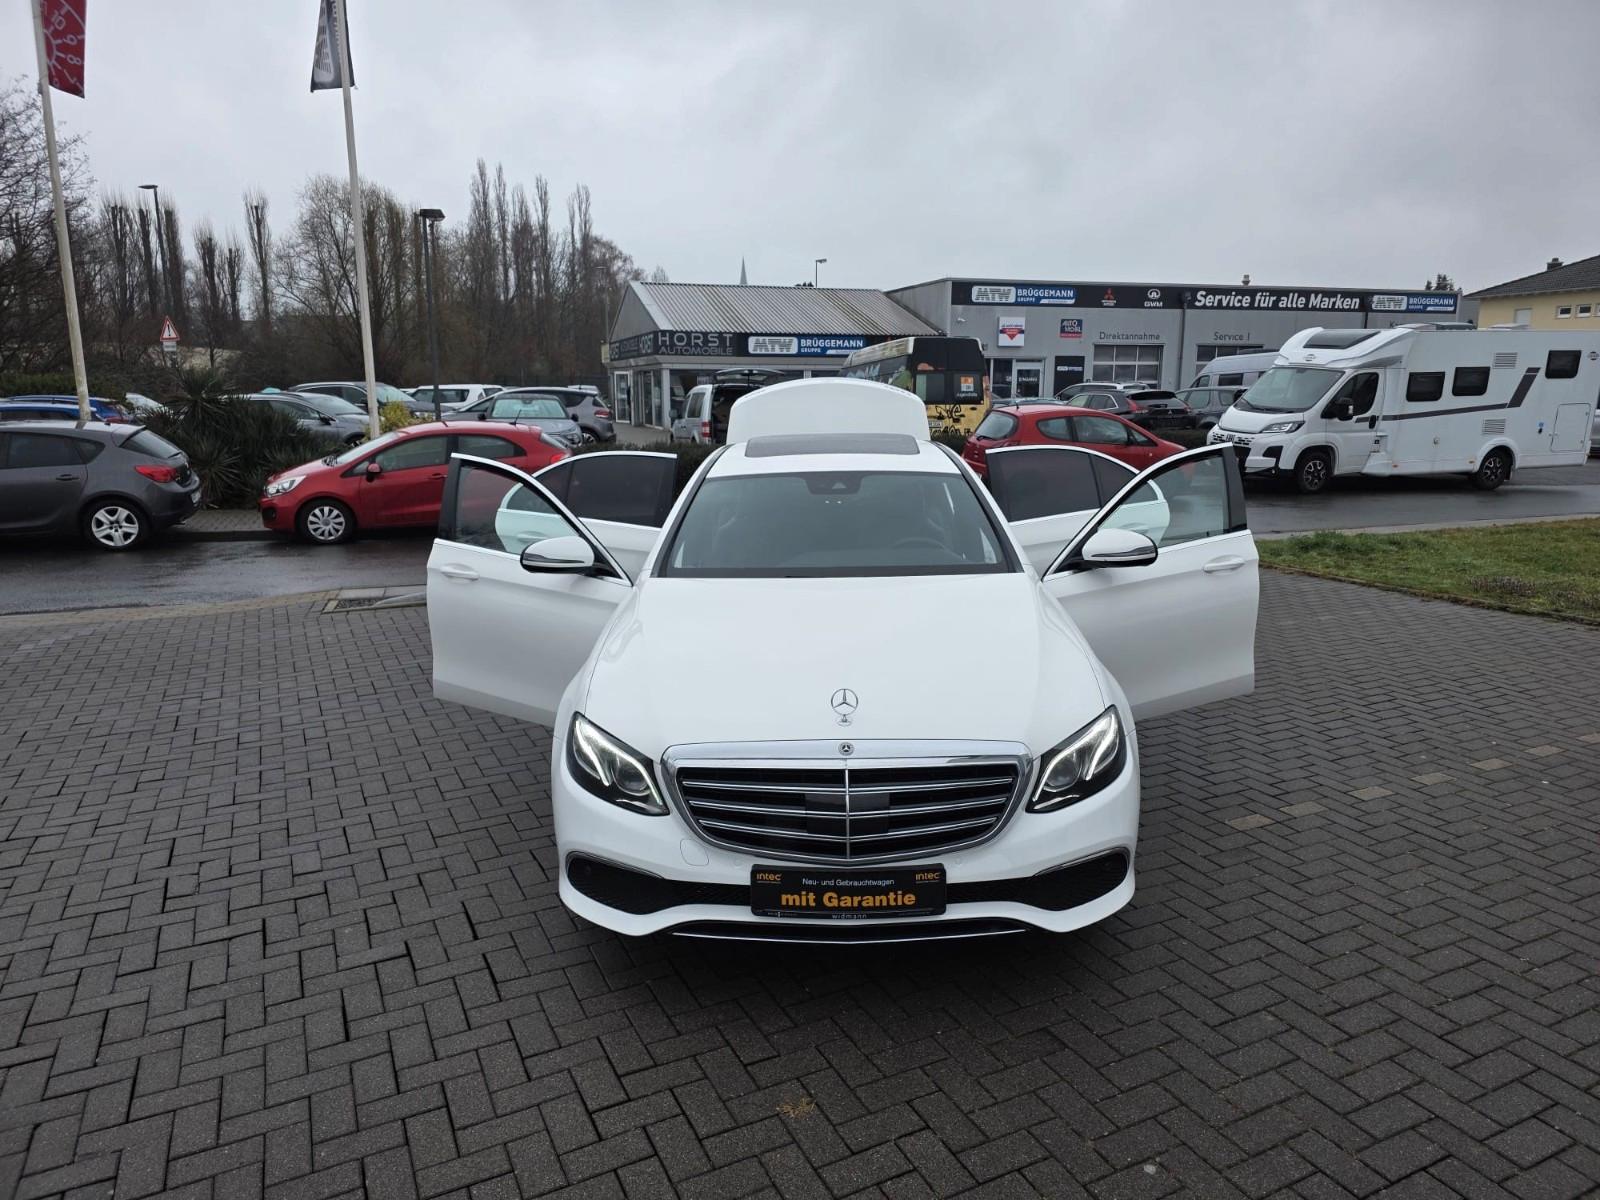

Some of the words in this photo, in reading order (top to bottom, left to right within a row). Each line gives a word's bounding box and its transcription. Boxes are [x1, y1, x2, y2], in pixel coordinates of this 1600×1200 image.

[1017, 287, 1074, 298] BRÜGGEMANN
[1194, 290, 1251, 307] Service
[1254, 291, 1276, 308] für
[1278, 292, 1306, 308] alle
[1308, 293, 1360, 309] Marken
[1408, 296, 1454, 305] BRÜGGEMANN
[658, 332, 733, 347] HORST
[1099, 331, 1161, 341] Direktannahme
[1213, 331, 1244, 341] Service
[800, 337, 863, 348] BRÜGGEMANN
[658, 346, 733, 356] AUTOMOBILE
[802, 878, 819, 886] Neu-
[820, 878, 834, 886] und
[835, 878, 895, 888] Gebrauchtwagen
[781, 890, 816, 907] mit
[823, 890, 916, 908] Garantie
